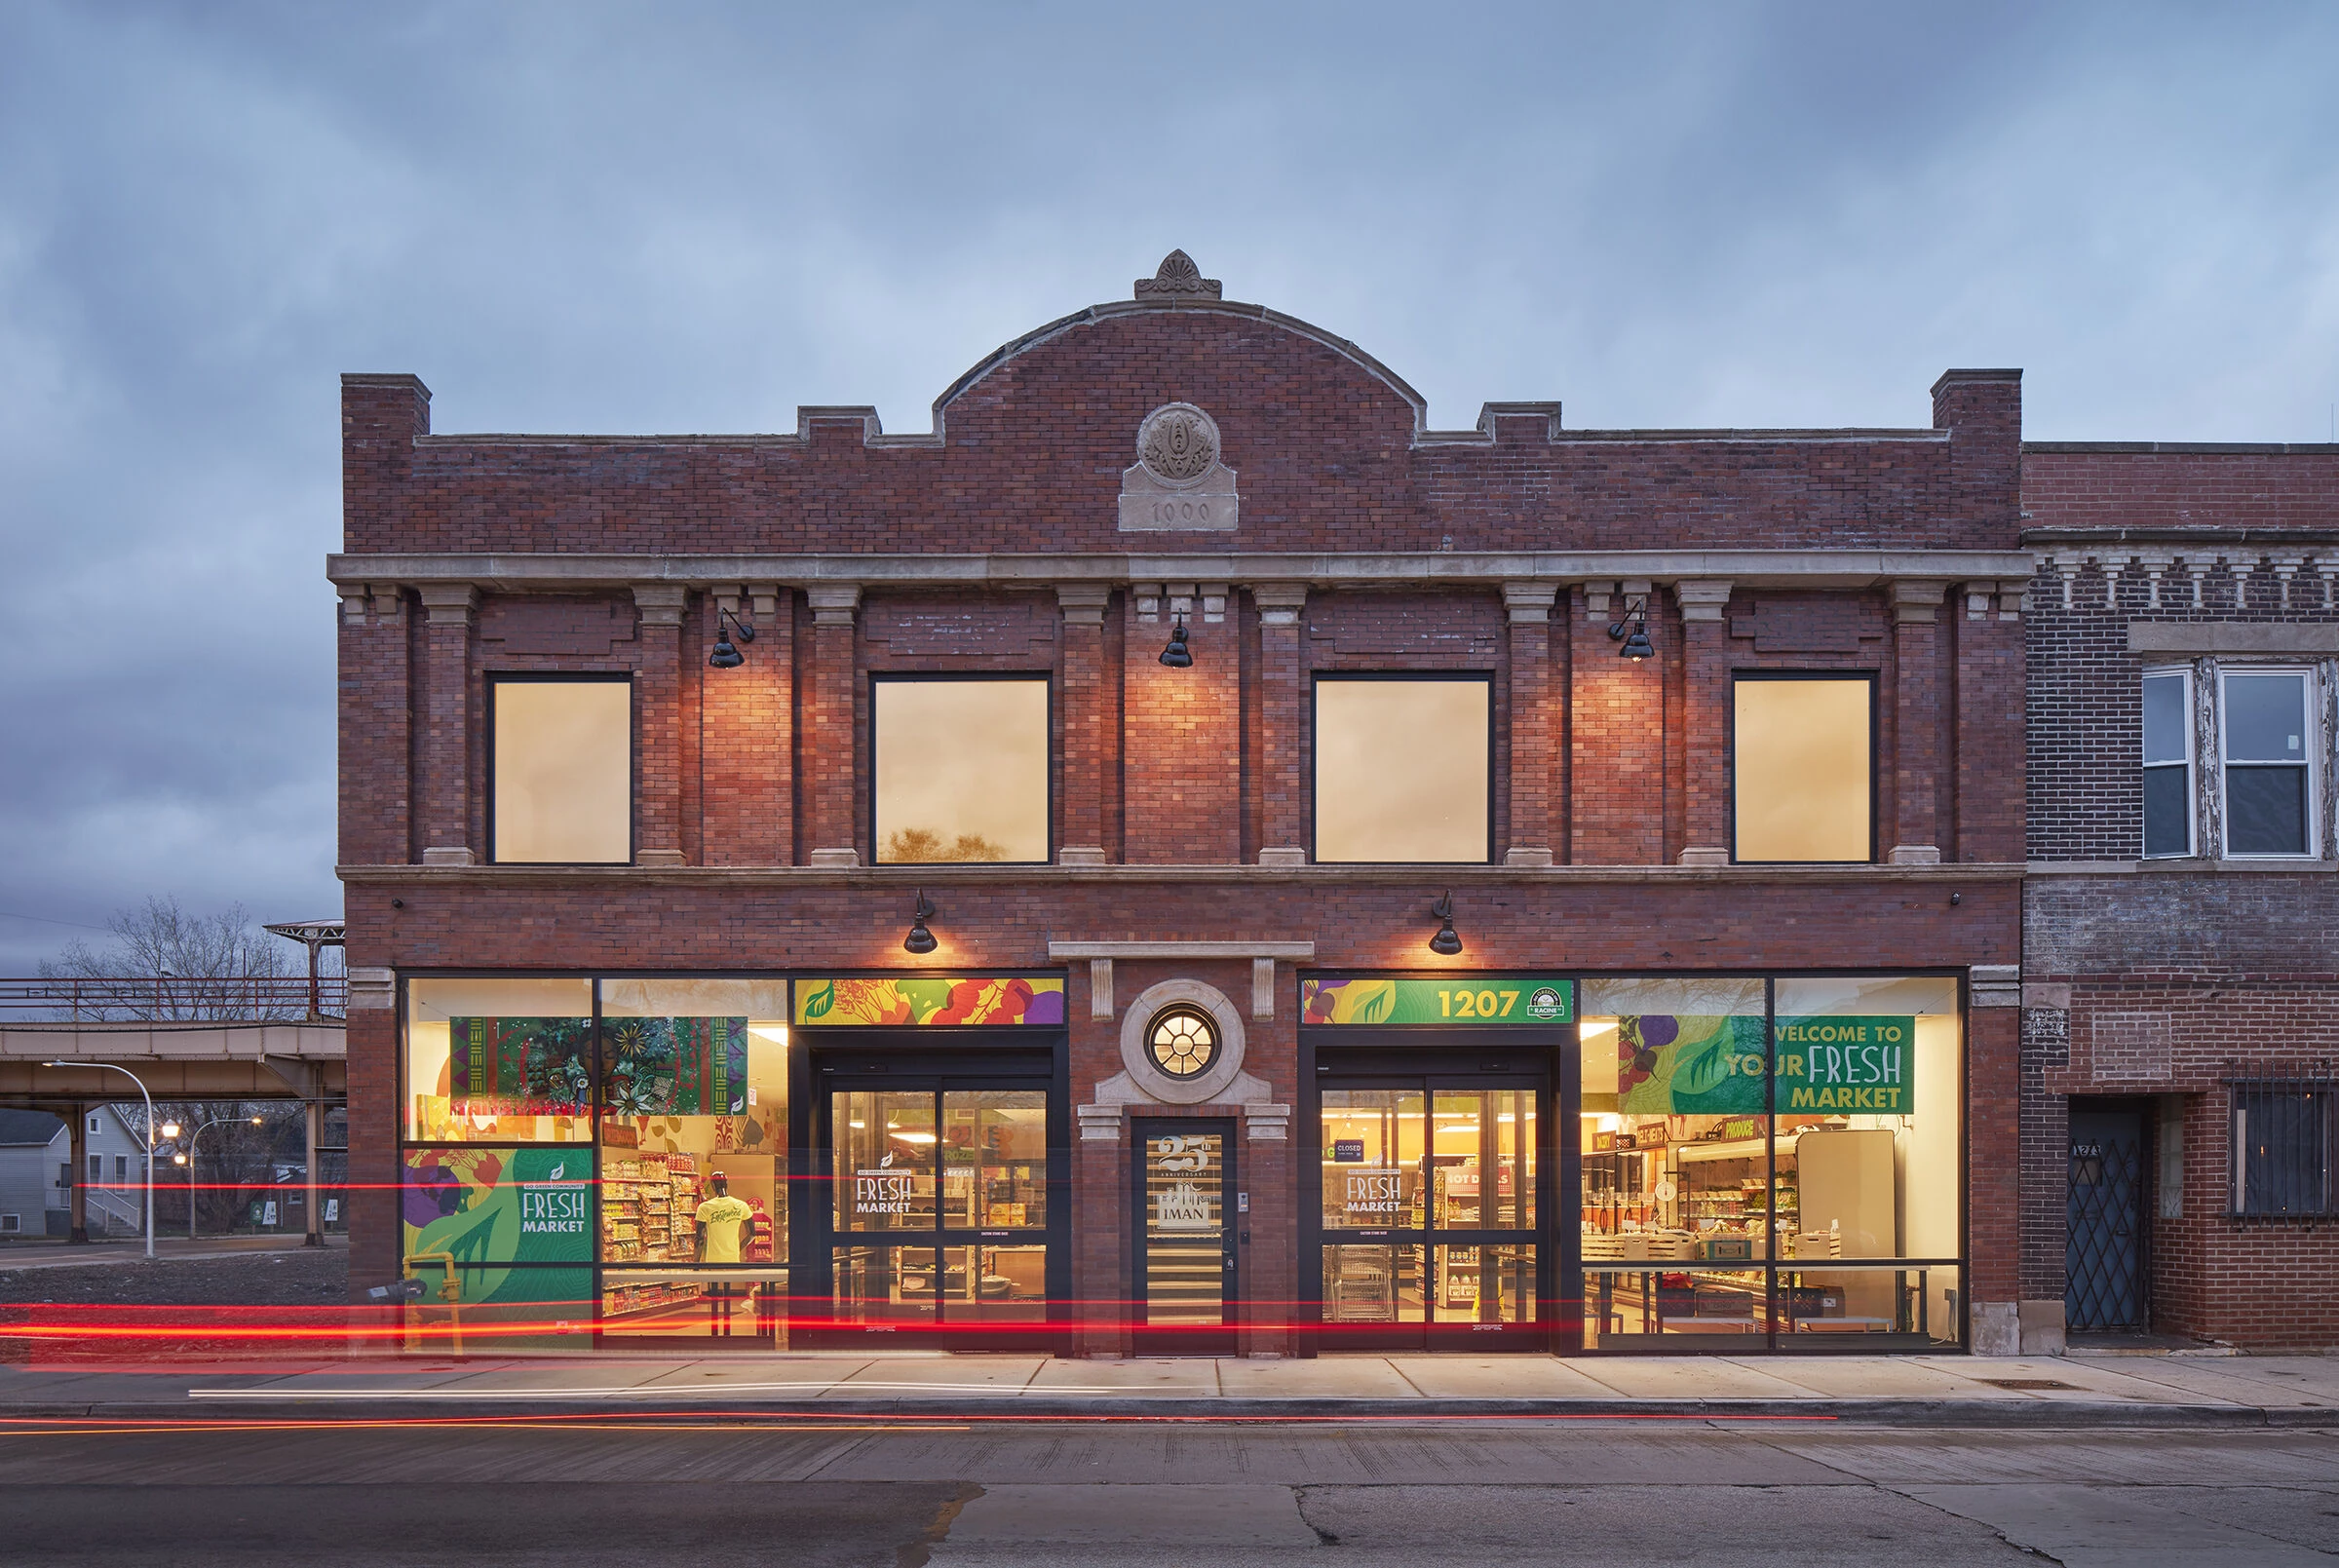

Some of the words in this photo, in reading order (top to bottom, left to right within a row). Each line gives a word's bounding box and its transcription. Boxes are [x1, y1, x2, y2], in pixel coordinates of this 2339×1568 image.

[1438, 990, 1520, 1017] 1207
[1874, 1026, 1902, 1042] TO
[1808, 1046, 1900, 1084] FRESH
[1790, 1087, 1901, 1108] MARKET
[857, 1177, 911, 1201] FRESH
[1347, 1176, 1400, 1200] FRESH
[523, 1192, 585, 1218] FRESH
[856, 1202, 911, 1213] MARKET
[1164, 1208, 1204, 1220] IMAN
[1346, 1202, 1401, 1212] MARKET
[522, 1220, 585, 1233] MARKET
